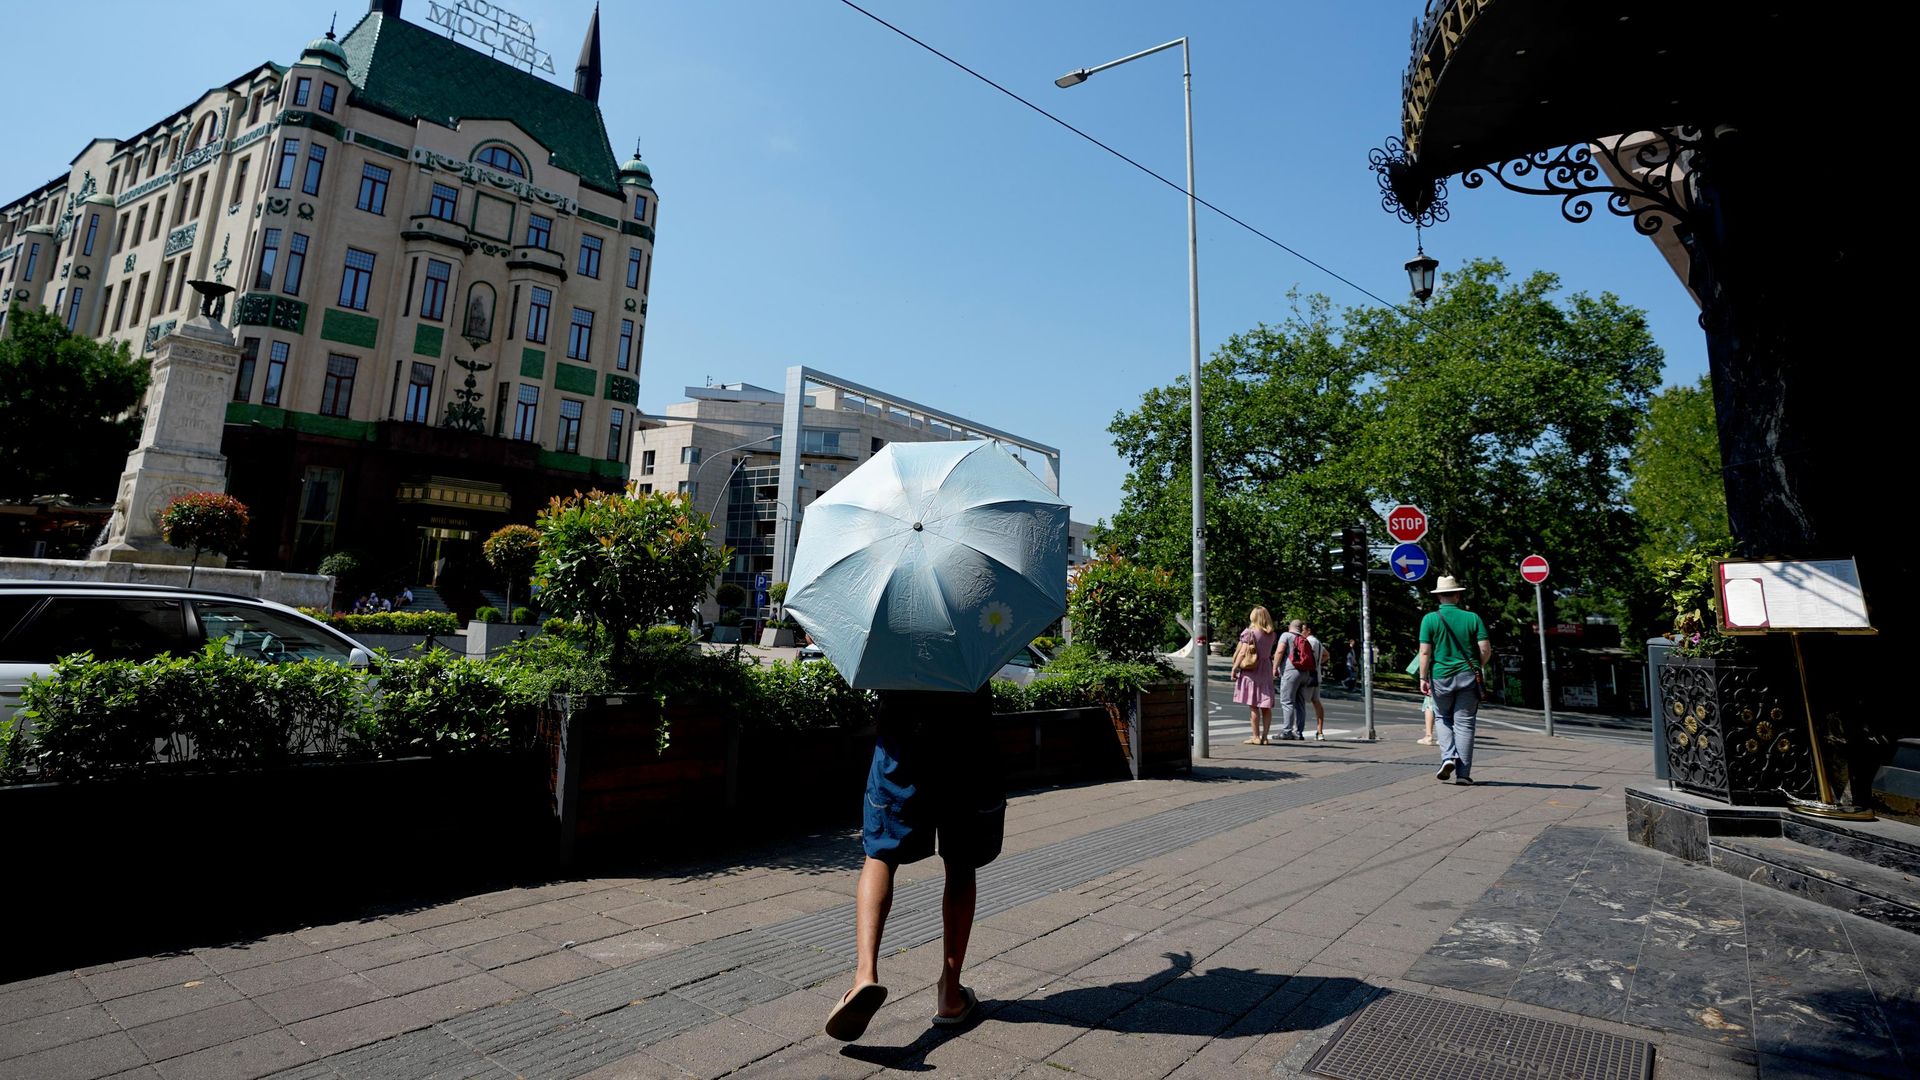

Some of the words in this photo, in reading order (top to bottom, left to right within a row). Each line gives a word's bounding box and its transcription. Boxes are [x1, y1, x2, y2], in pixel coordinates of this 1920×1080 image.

[426, 0, 556, 75] МОСКВА
[1391, 518, 1423, 530] STOP
[758, 577, 765, 587] P
[1431, 1039, 1540, 1072] TELEFON
